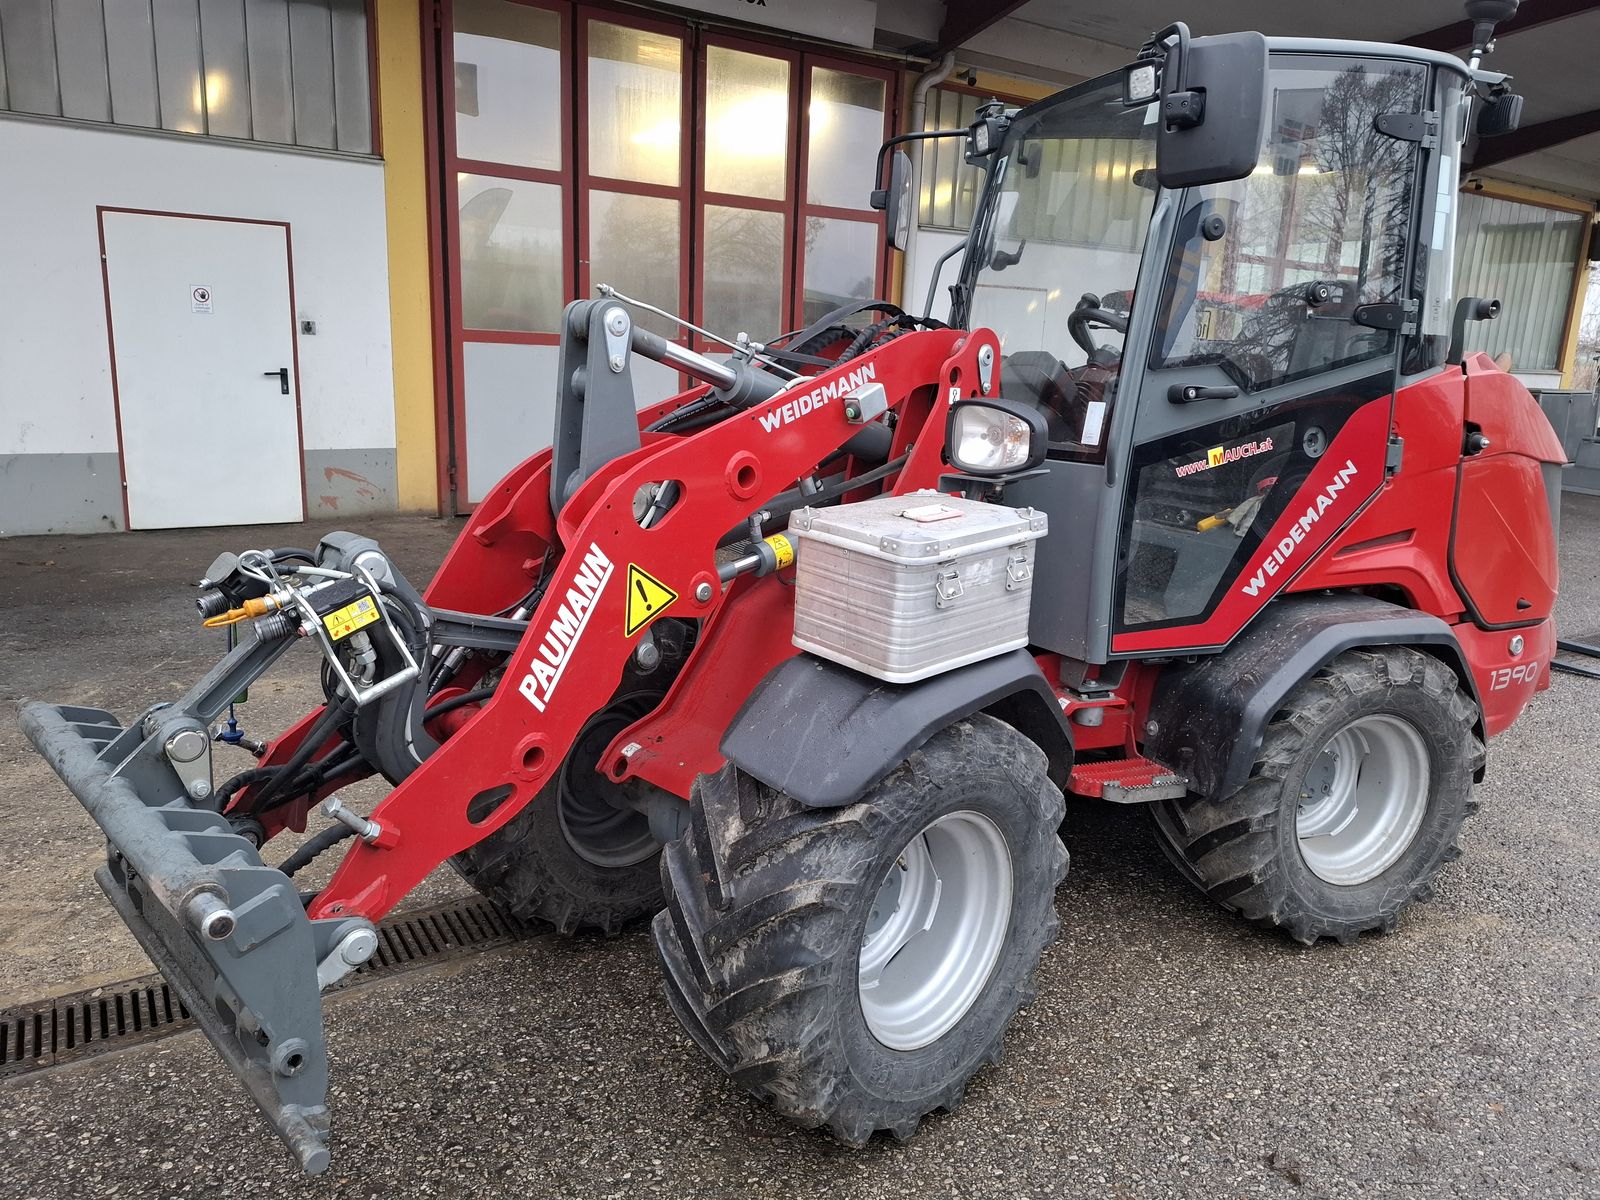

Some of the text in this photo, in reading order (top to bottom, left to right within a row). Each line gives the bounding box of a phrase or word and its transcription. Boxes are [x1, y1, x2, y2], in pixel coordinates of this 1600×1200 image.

[758, 362, 876, 433] WEIDEMANN
[1175, 437, 1273, 477] www.MAUCH.at
[1241, 459, 1358, 597] WEIDEMANN
[518, 542, 612, 713] PAUMANN
[1490, 662, 1538, 691] 1390
